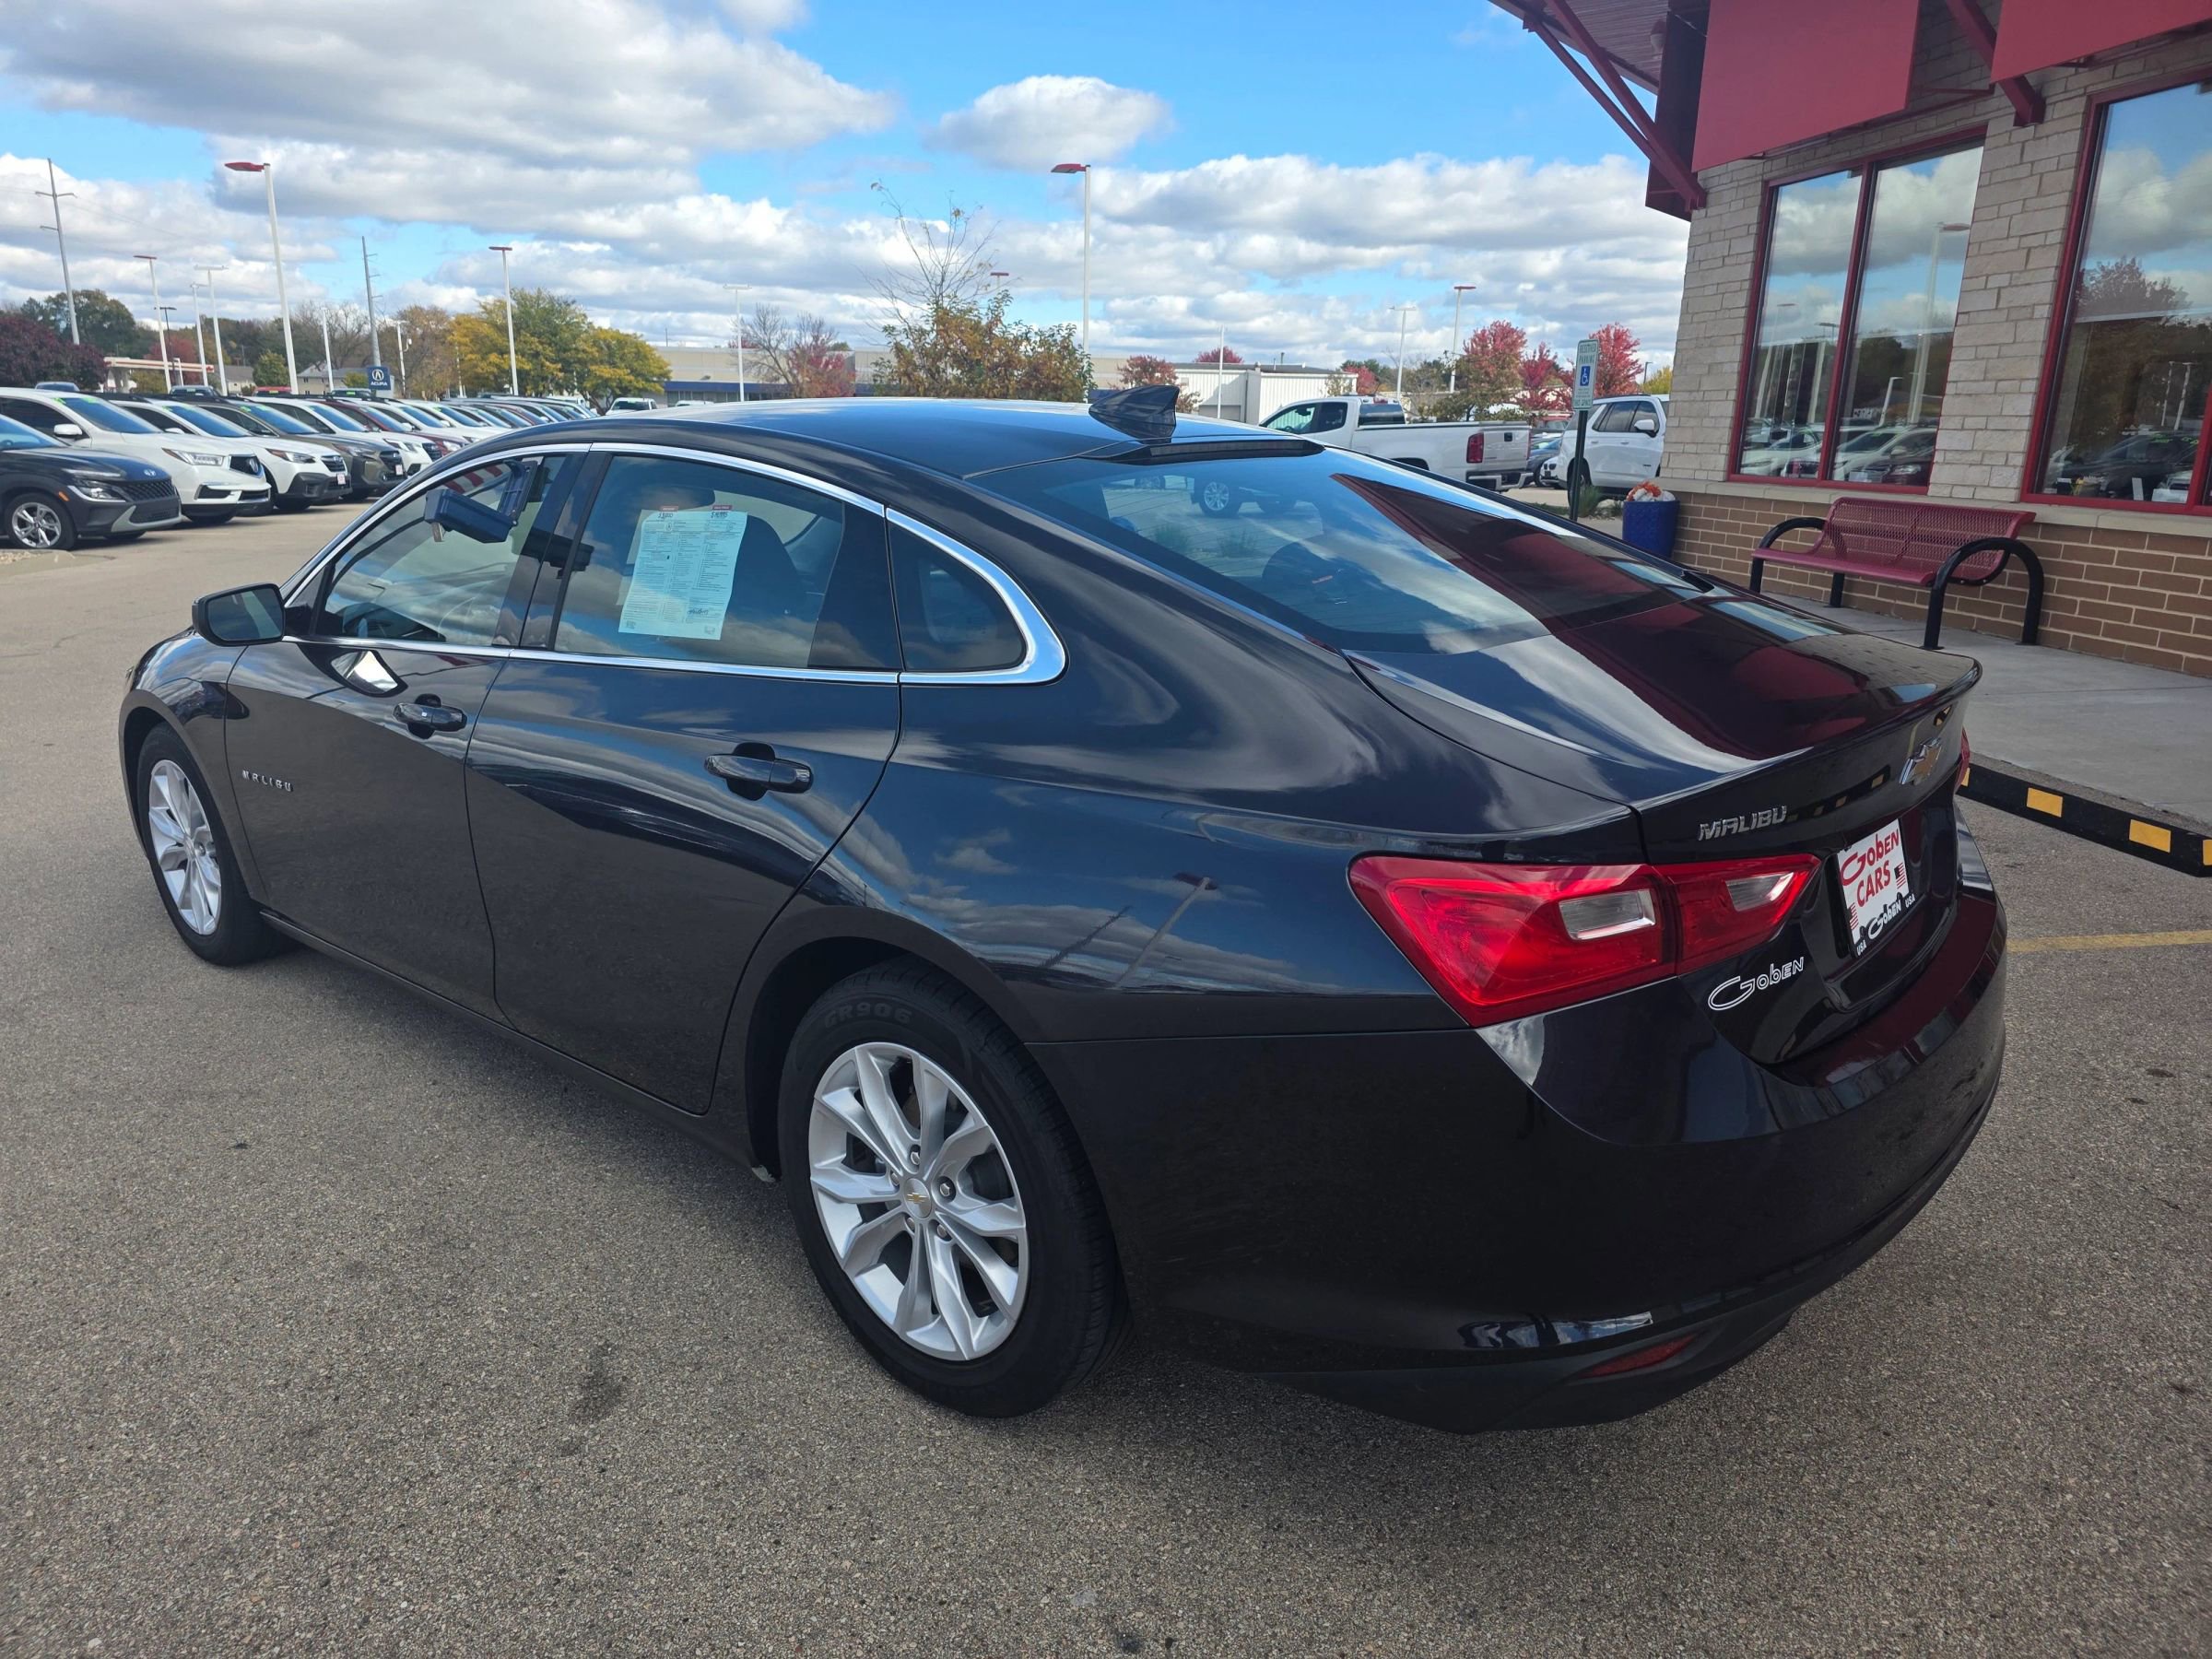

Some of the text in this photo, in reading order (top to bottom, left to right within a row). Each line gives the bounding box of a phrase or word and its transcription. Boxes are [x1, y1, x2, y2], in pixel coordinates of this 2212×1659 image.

[241, 770, 292, 792] MALIBU
[1698, 806, 1787, 841] MALIBU
[1856, 860, 1891, 907] CARS
[1856, 939, 1868, 956] USA
[1904, 893, 1916, 909] USA
